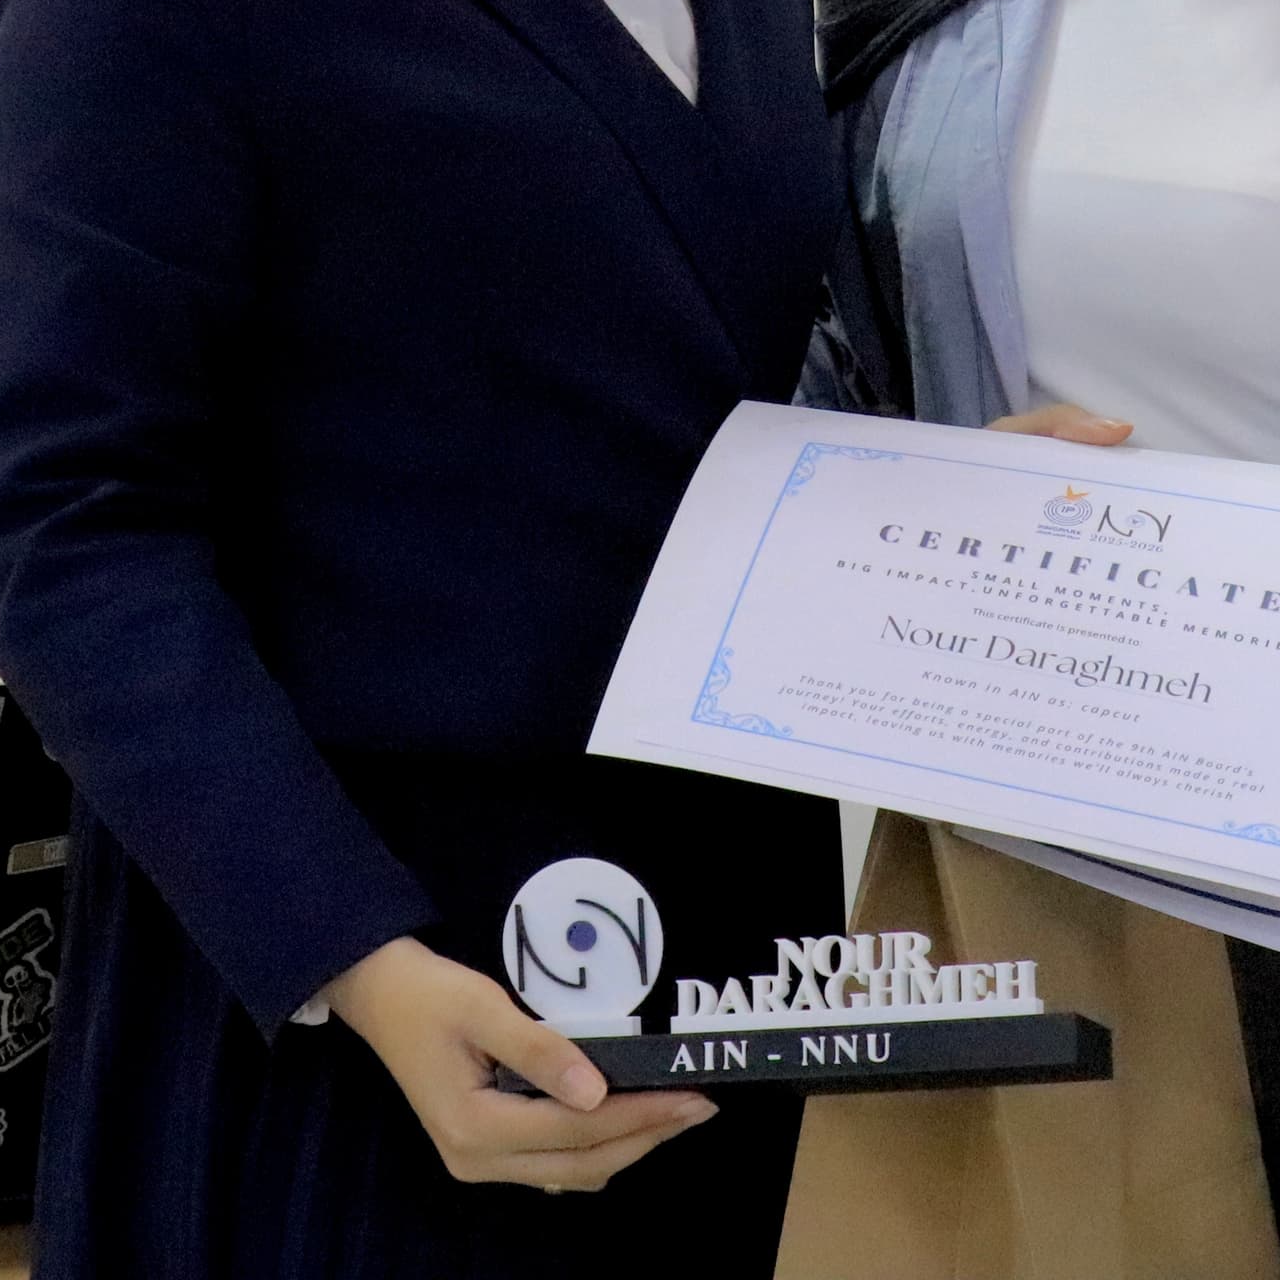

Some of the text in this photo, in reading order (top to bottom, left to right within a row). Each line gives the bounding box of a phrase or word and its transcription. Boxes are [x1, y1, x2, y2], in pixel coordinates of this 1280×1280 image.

[835, 558, 873, 575] BIG
[1089, 533, 1164, 553] 2025-2026
[970, 569, 1040, 592] SMALL
[972, 607, 995, 620] This
[996, 610, 1054, 632] certificate
[1056, 624, 1066, 633] is
[1067, 626, 1131, 648] presented
[879, 615, 1213, 704] Nour Daraghmeh
[921, 670, 1142, 723] Known in AIN as: capcut
[777, 685, 1266, 794] journey! Your efforts, energy, and contributions made a real
[799, 674, 1255, 778] Thank you for being a special part of the 9th AIN Board's
[801, 702, 1235, 801] impact, leaving us with memories we'll always cherish
[773, 930, 937, 982] NOUR
[676, 959, 1039, 1018] DARAGHMEH
[669, 1038, 749, 1074] AIN
[800, 1032, 894, 1069] NNU
